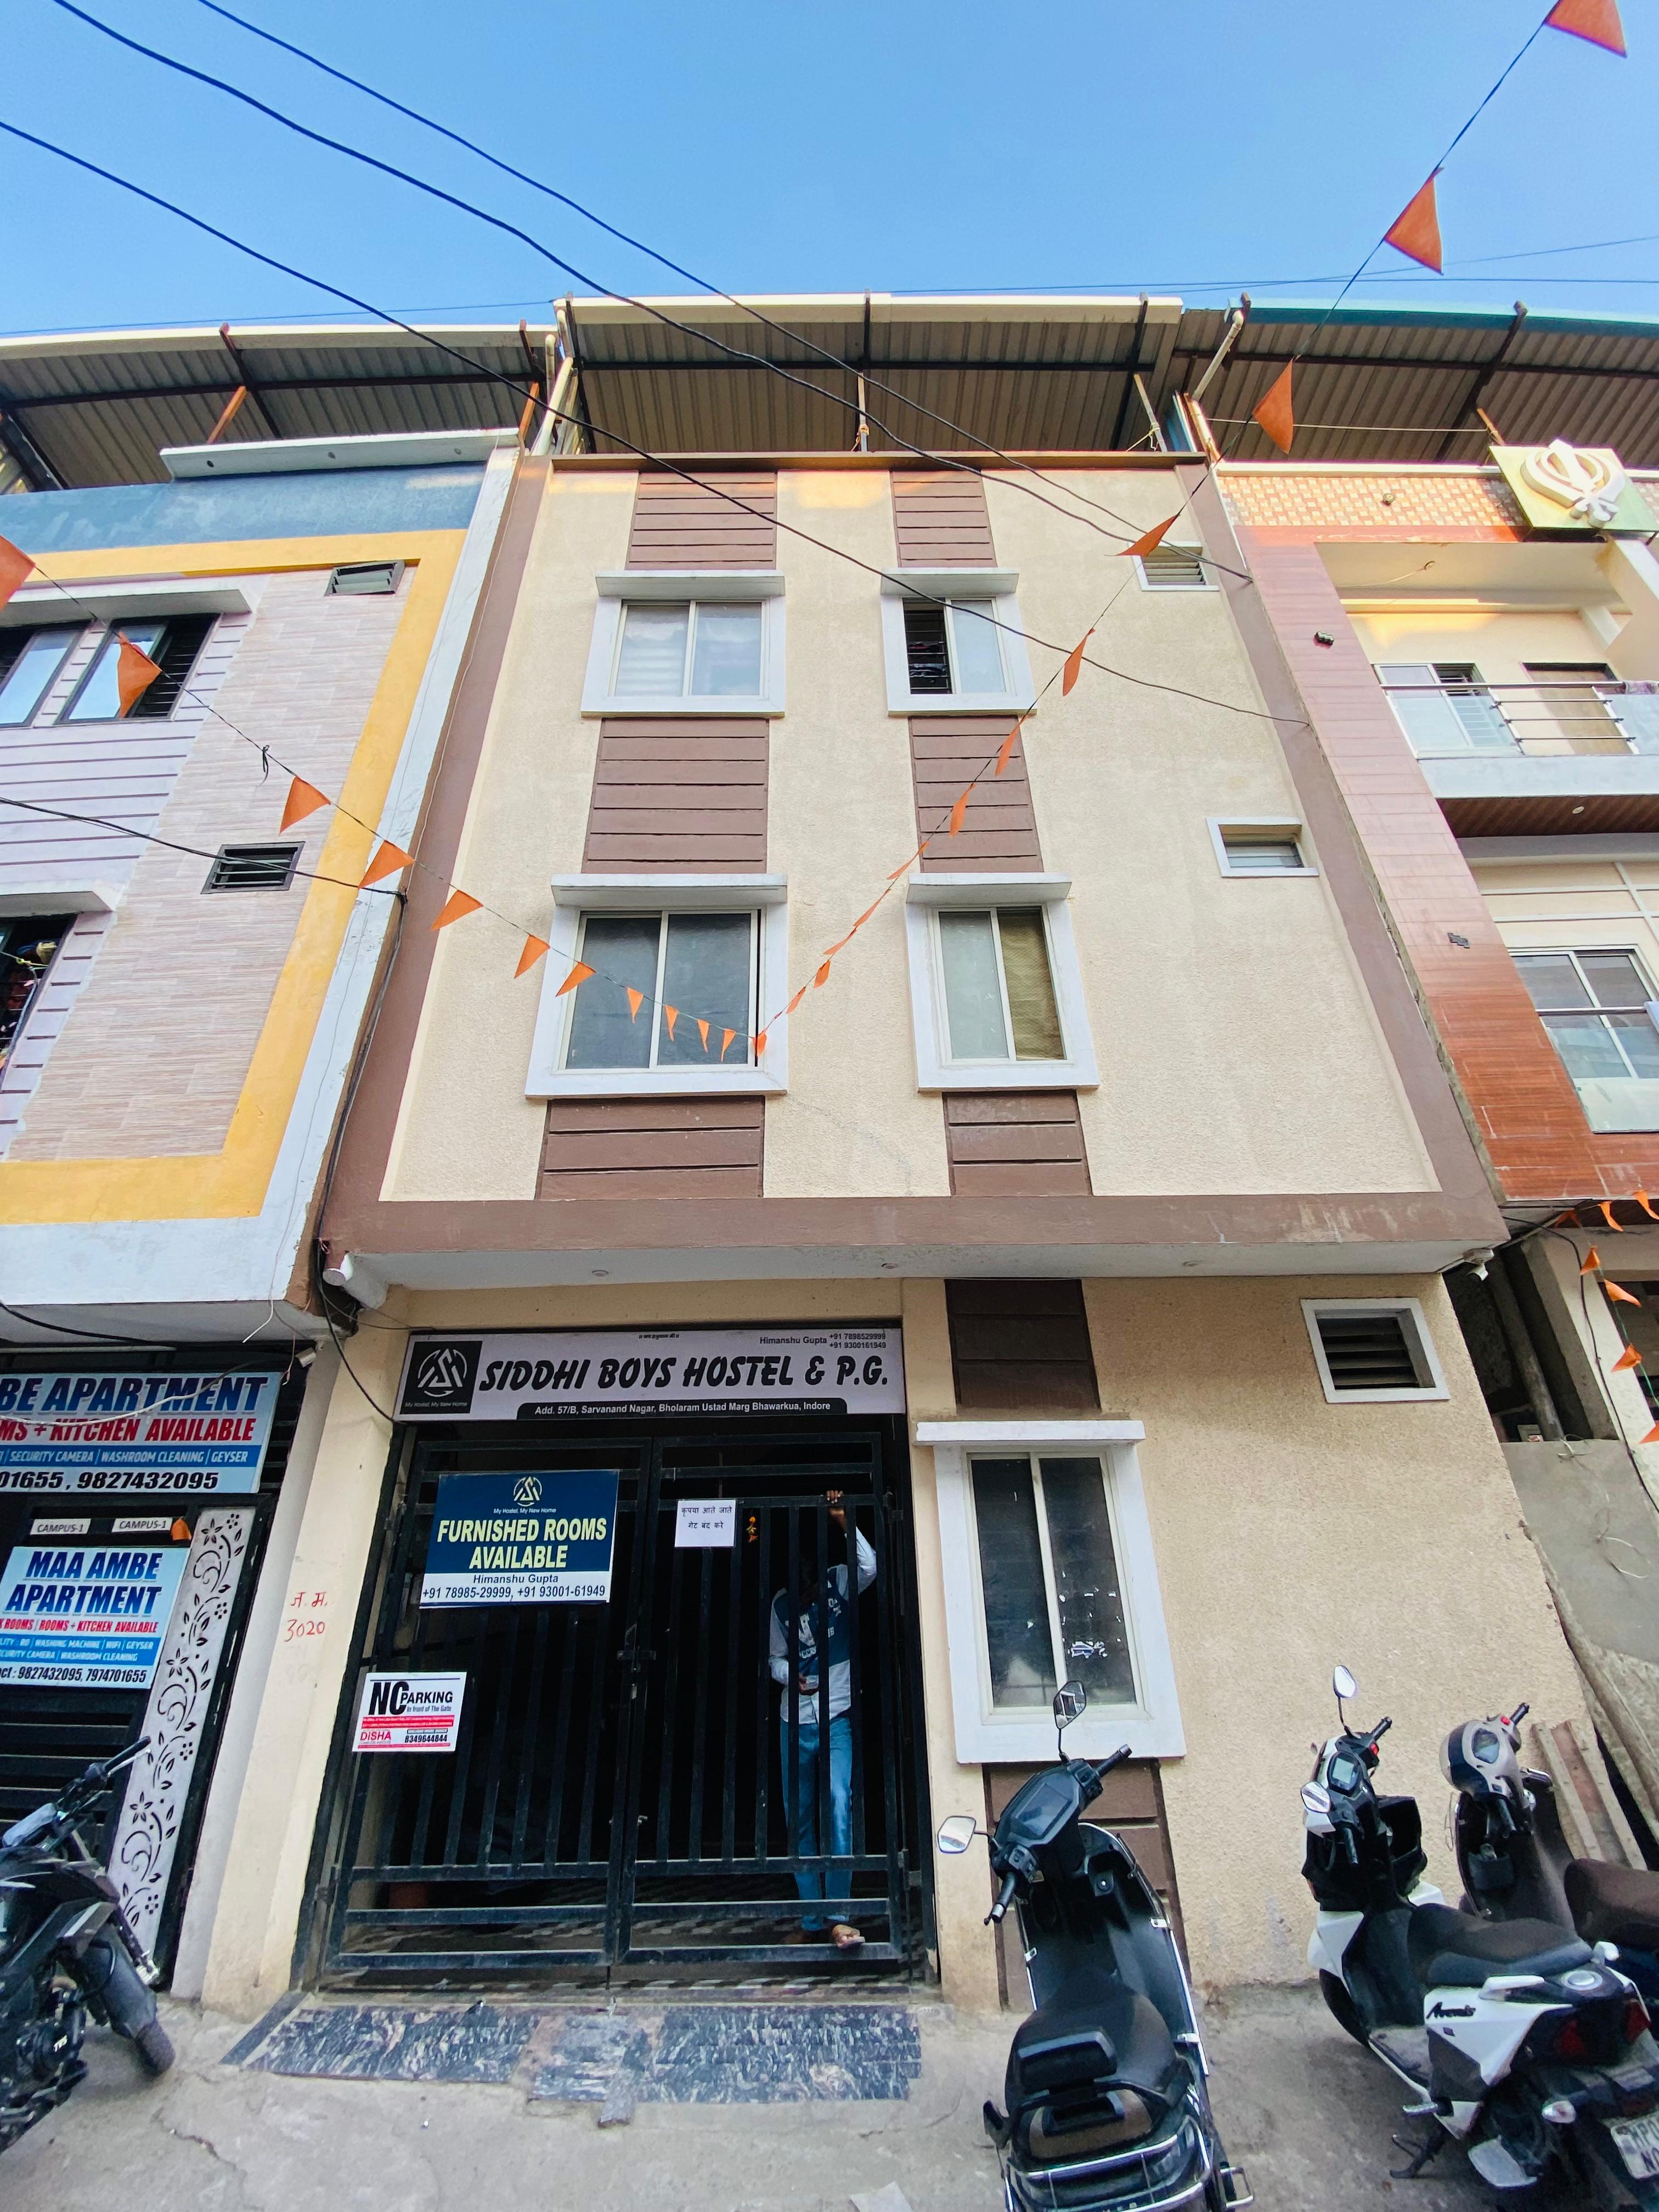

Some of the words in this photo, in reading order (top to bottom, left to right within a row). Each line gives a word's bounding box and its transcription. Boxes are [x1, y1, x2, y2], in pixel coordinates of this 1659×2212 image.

[803, 1336, 827, 1345] Gupta
[479, 1359, 591, 1391] SIDDHI
[597, 1357, 677, 1389] BOYS
[682, 1356, 793, 1387] HOSTEL
[805, 1356, 825, 1385] &
[837, 1355, 888, 1385] P.G.
[0, 1378, 43, 1411] BE
[42, 1377, 268, 1411] APARTMENT
[535, 1406, 555, 1414] Add.
[557, 1406, 579, 1415] 57/B,
[582, 1405, 627, 1414] Sarvanand
[629, 1404, 656, 1414] Nagar,
[659, 1403, 699, 1412] Bholaram
[702, 1402, 726, 1411] Ustad
[729, 1402, 749, 1412] Marg
[752, 1402, 801, 1412] Bhawarkua,
[804, 1402, 831, 1410] Indore
[49, 1418, 140, 1441] KITCHEN
[145, 1418, 256, 1441] AVAILABLE
[9, 1451, 54, 1463] SECURITY
[55, 1451, 94, 1463] CAMERA
[101, 1451, 155, 1463] WASHROOM
[157, 1451, 205, 1463] CLEANING
[211, 1451, 248, 1463] GEYSER
[77, 1472, 218, 1489] 9827432095
[681, 1507, 699, 1517] कृपया
[703, 1505, 716, 1514] आते
[719, 1505, 732, 1514] जाते
[37, 1523, 84, 1532] CAMPUS-1
[119, 1520, 166, 1530] CAMPUS-1
[437, 1519, 539, 1543] FURNISHED
[543, 1517, 607, 1541] ROOMS
[688, 1521, 698, 1529] गेट
[469, 1544, 568, 1570] AVAILABLE
[26, 1551, 84, 1578] MAA
[86, 1552, 163, 1580] AMBE
[473, 1575, 524, 1584] Himanshu
[528, 1574, 558, 1585] Gupta
[5, 1583, 162, 1614] APARTMENT
[422, 1587, 441, 1599] +91
[445, 1587, 514, 1599] 78985-29999,
[517, 1586, 535, 1598] +91
[539, 1585, 605, 1598] 93001-61949
[4, 1618, 35, 1630] ROOMS
[39, 1620, 70, 1632] ROOMS
[77, 1621, 113, 1632] KITCHEN
[114, 1622, 159, 1633] AVAILABLE
[284, 1619, 325, 1642] 3020
[126, 1641, 154, 1650] GEYSER
[27, 1650, 55, 1659] CAMERA
[103, 1652, 138, 1662] CLEANING
[86, 1668, 147, 1683] 7974701655
[400, 1691, 453, 1705] PARKING
[360, 1731, 392, 1741] DISHA
